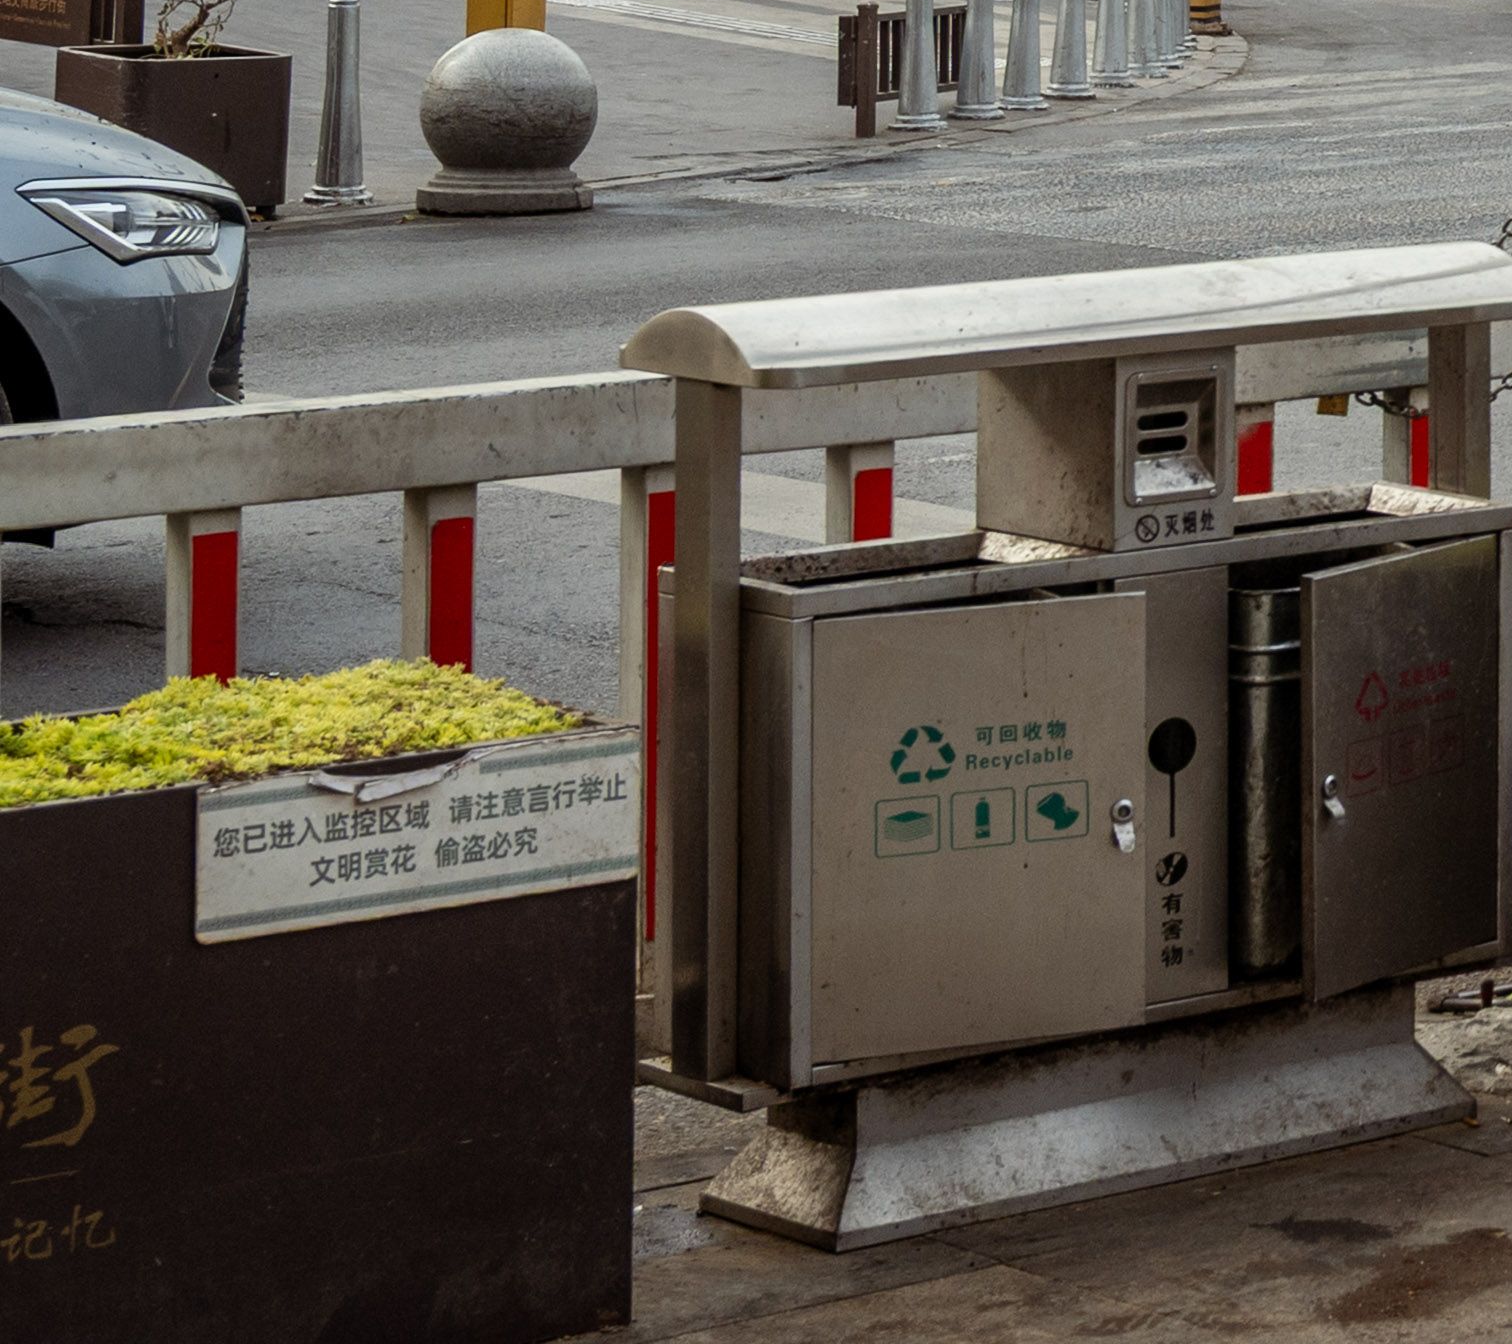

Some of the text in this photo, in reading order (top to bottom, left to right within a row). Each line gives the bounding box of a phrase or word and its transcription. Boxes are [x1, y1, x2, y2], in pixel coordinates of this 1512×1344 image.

[1164, 510, 1215, 538] 灭烟处
[976, 720, 1067, 745] 可回收物
[966, 746, 1074, 770] Recyclable
[213, 773, 628, 859] 您已进入监控区域 请注意言行举止
[309, 826, 539, 887] 文明赏花 偷盗必究
[1161, 893, 1183, 968] 有害物
